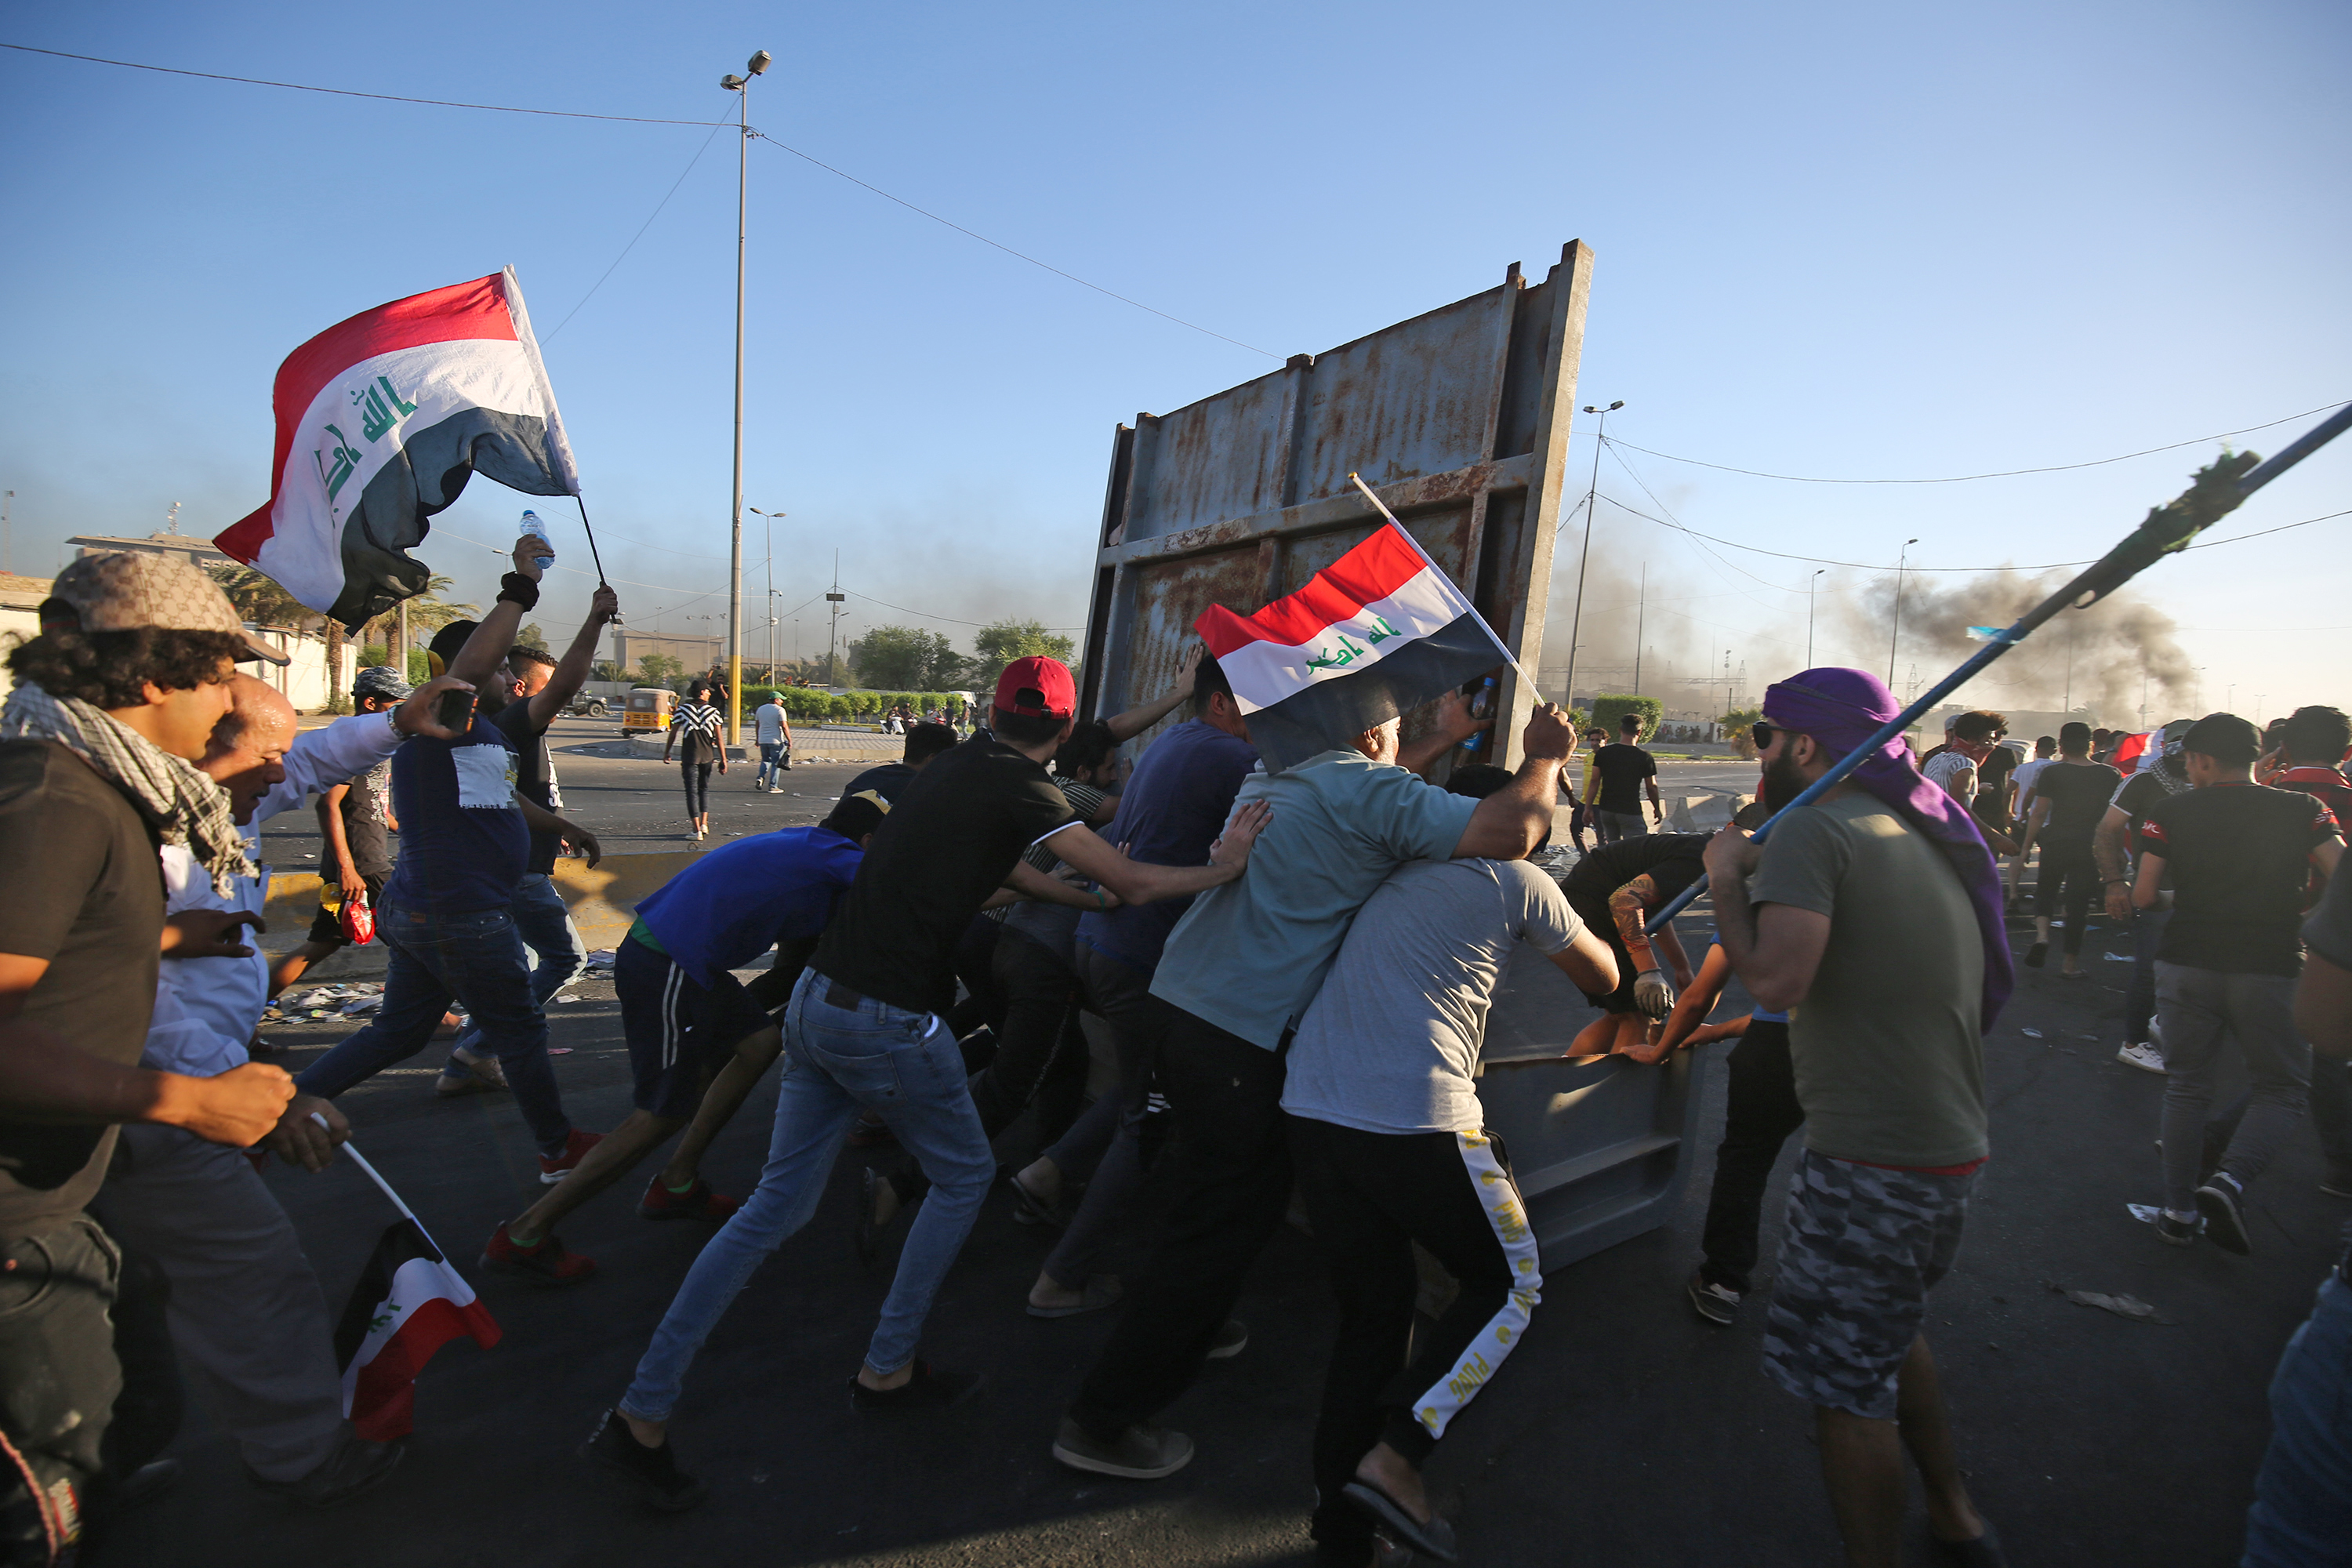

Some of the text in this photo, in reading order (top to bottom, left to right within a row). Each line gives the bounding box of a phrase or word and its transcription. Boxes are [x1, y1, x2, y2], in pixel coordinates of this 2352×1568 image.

[314, 376, 418, 530] الله اك
[1493, 1200, 1526, 1243] PUBG
[1449, 1352, 1490, 1403] PUBG
